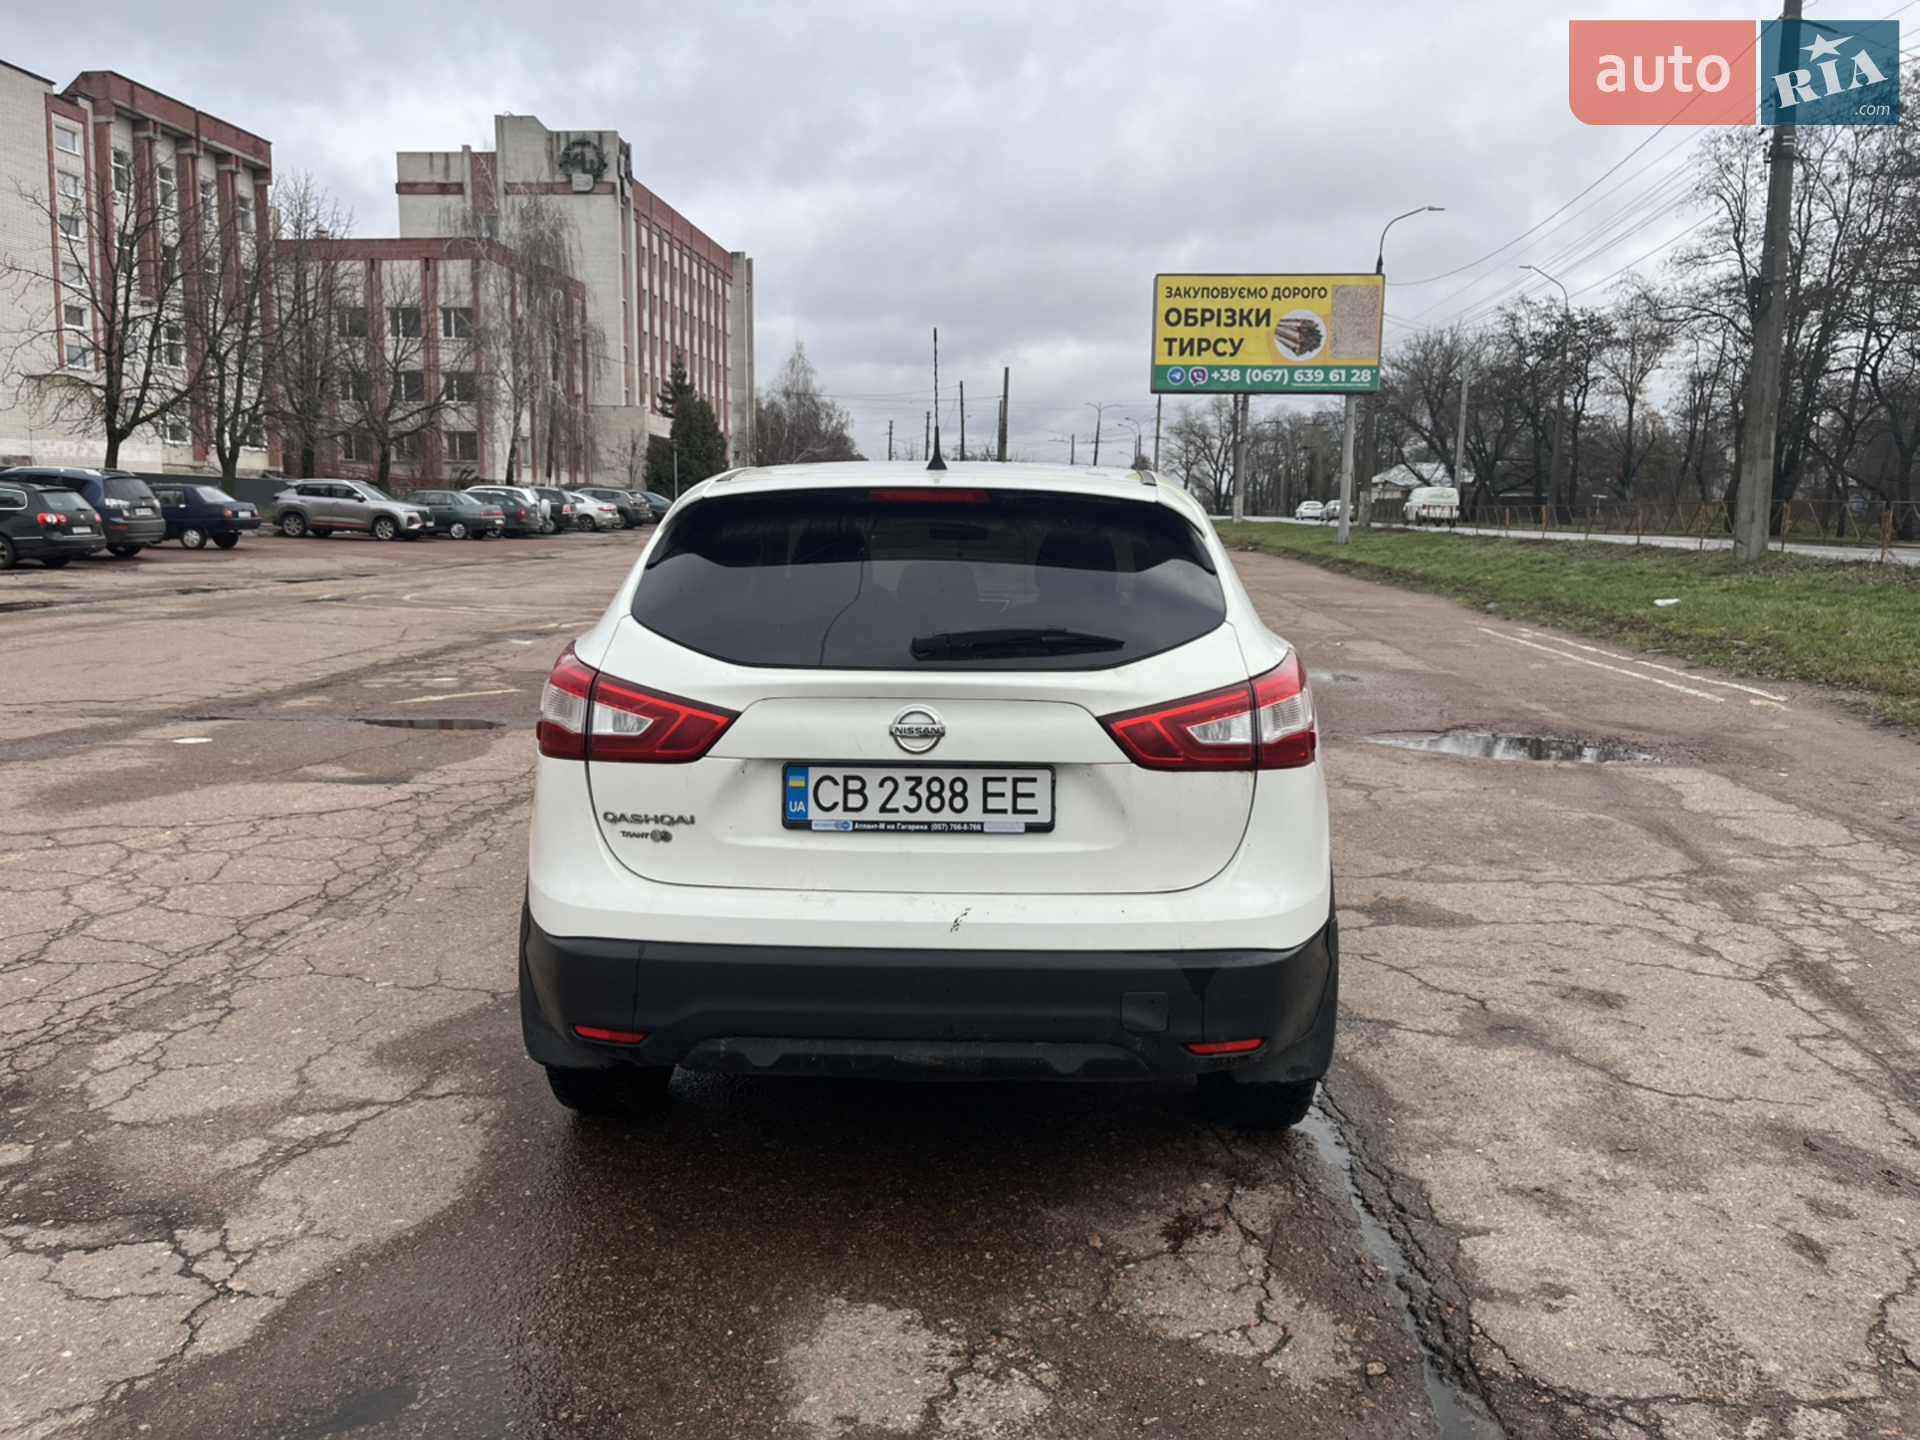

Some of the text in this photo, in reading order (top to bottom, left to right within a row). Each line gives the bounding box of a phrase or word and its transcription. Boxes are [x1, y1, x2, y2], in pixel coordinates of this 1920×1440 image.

[1165, 286, 1328, 301] ЗАКУПОВУЄМО ДОРОГО
[1164, 307, 1271, 328] ОБРІЗКИ
[1163, 337, 1245, 357] ТИРСУ
[1211, 369, 1241, 382] +38
[1246, 369, 1289, 385] (067)
[1293, 369, 1325, 382] 639
[1328, 369, 1346, 382] 61
[894, 726, 940, 734] NISSAN
[812, 775, 1039, 815] CB 2388 EE
[789, 801, 806, 812] UA
[603, 811, 696, 827] QASHQAI
[896, 823, 928, 831] Гагарина
